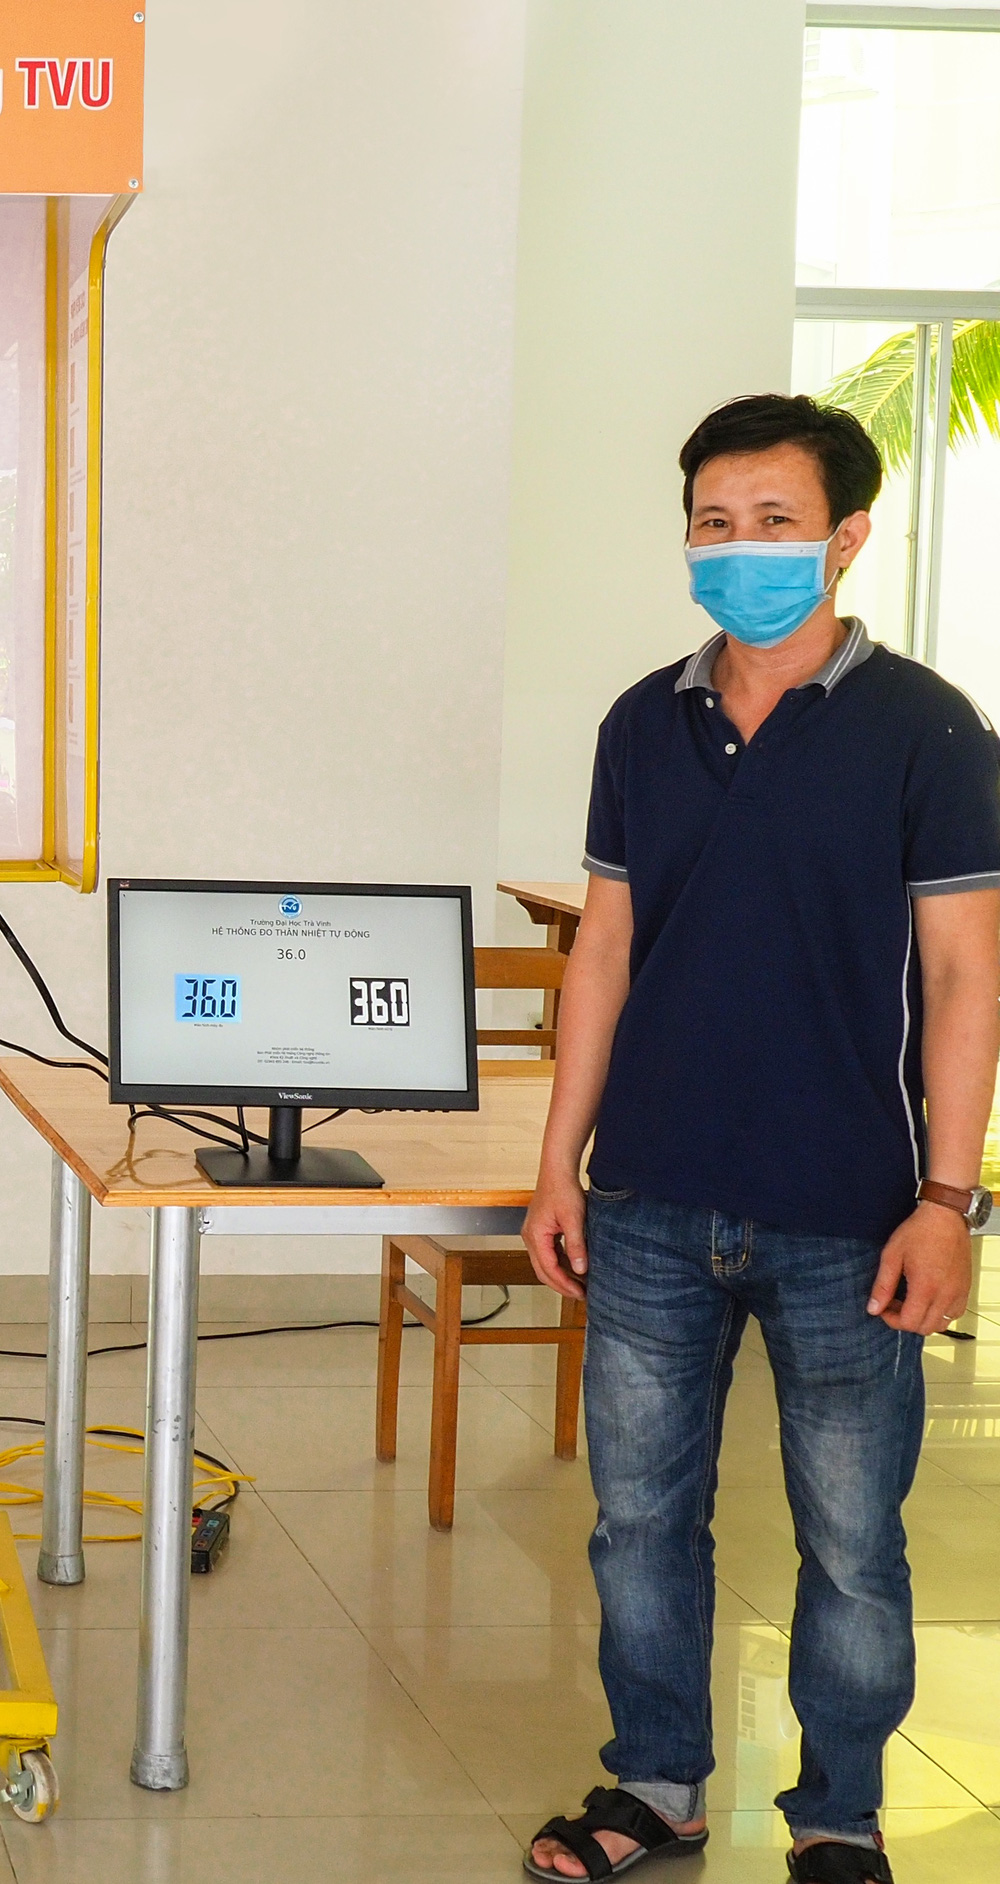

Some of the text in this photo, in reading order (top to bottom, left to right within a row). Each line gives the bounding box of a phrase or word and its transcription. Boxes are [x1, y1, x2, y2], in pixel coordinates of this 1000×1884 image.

[15, 57, 114, 110] TVU
[275, 919, 288, 927] Đại
[259, 928, 273, 936] ĐO
[275, 927, 299, 937] THÂN
[276, 948, 307, 960] 36.0
[181, 978, 238, 1018] 36.0
[351, 980, 409, 1024] 360
[278, 1092, 314, 1101] ViewSonic
